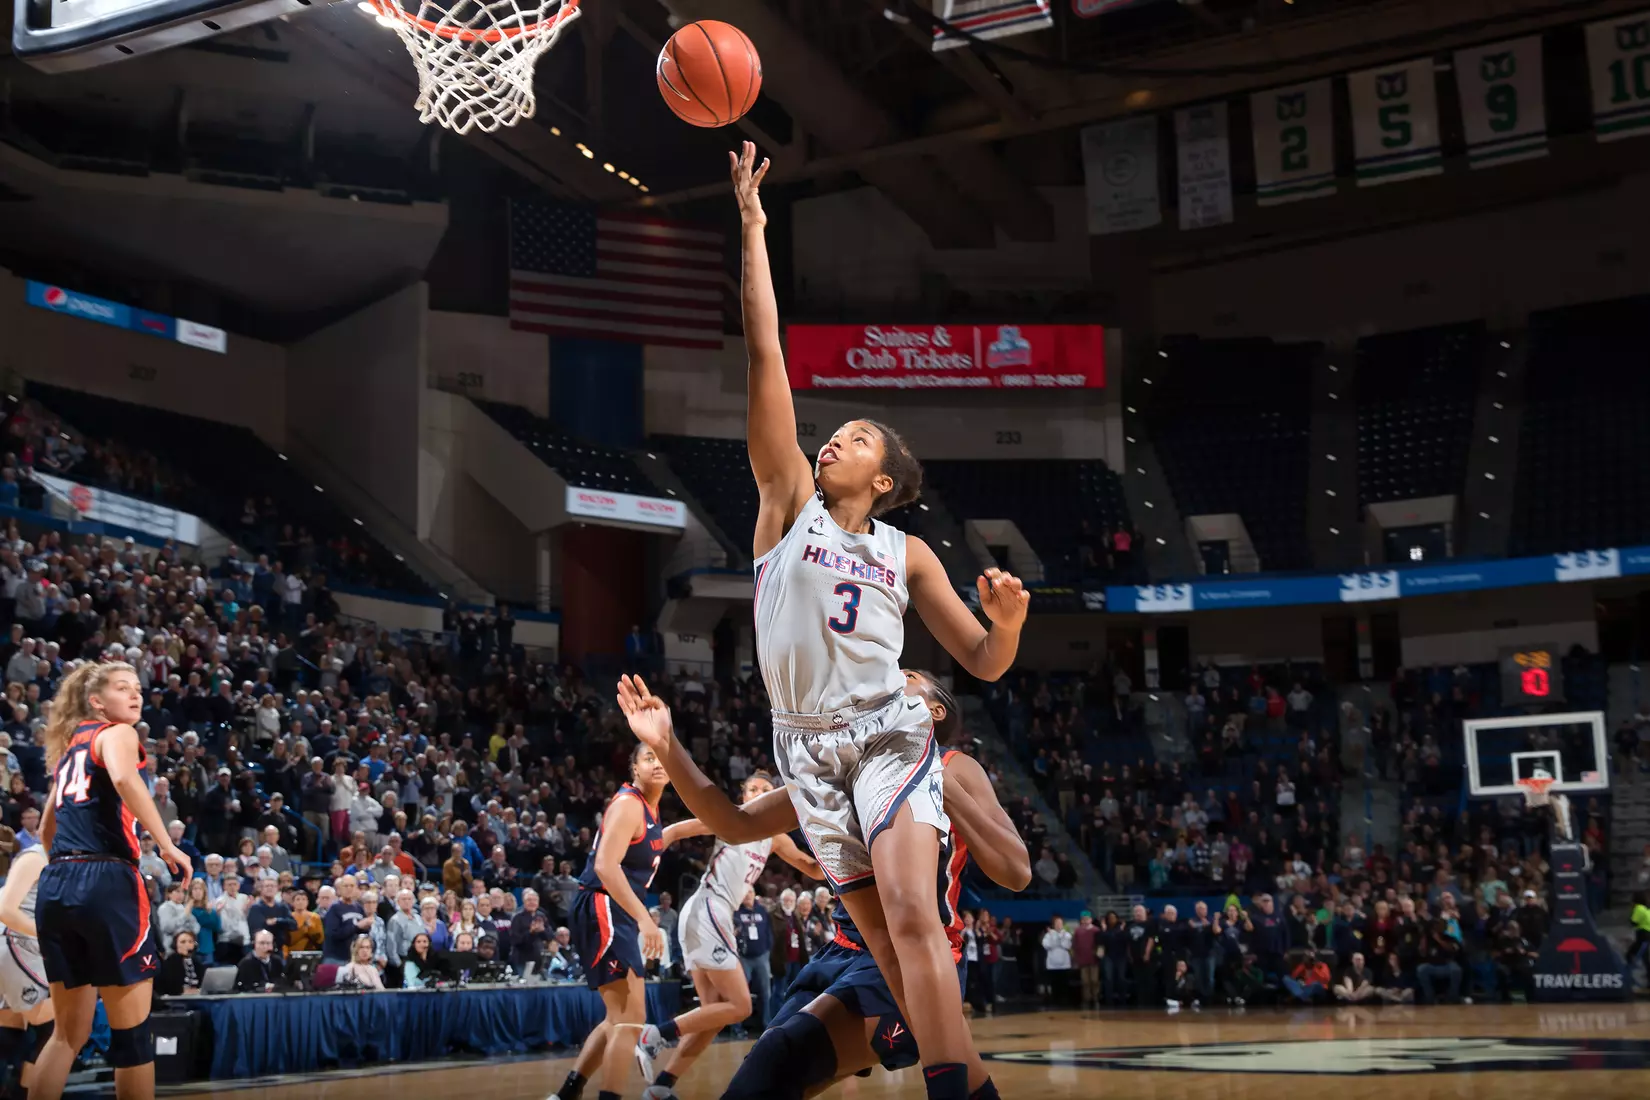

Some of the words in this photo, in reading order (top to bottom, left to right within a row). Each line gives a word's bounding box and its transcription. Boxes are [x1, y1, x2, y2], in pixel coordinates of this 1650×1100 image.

[1484, 83, 1517, 133] 9
[1377, 104, 1412, 149] 5
[1280, 126, 1308, 172] 2
[932, 325, 952, 347] &
[846, 347, 897, 369] Club
[898, 347, 973, 369] Tickets
[995, 431, 1022, 445] 233
[802, 544, 896, 588] HUSKIES
[827, 581, 862, 635] 3
[678, 634, 698, 644] 107
[829, 723, 850, 731] UCONN
[55, 749, 92, 808] 14
[744, 863, 761, 886] 20
[1533, 973, 1624, 989] TRAVELERS
